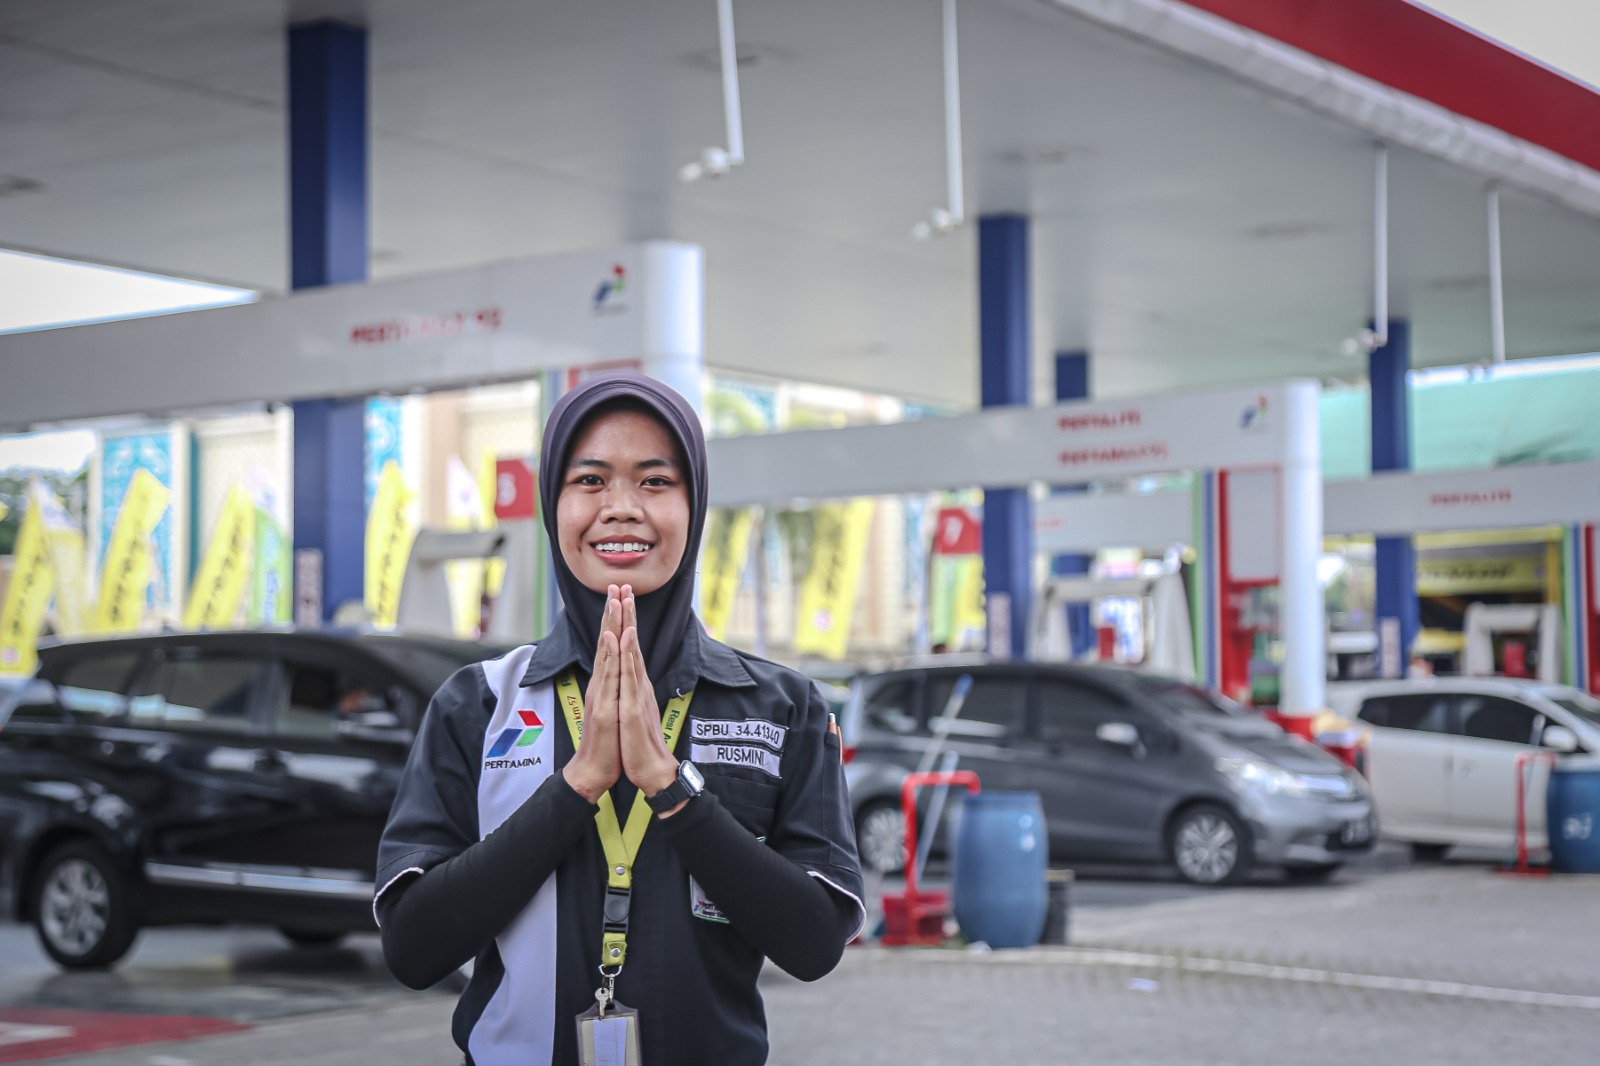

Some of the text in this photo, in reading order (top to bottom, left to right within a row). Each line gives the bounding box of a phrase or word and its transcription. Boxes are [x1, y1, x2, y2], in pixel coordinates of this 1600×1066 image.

[665, 709, 680, 730] Rest
[696, 724, 780, 744] SPBU 34.41340
[484, 757, 542, 770] PERTAMINA
[717, 747, 767, 766] RUSMINI
